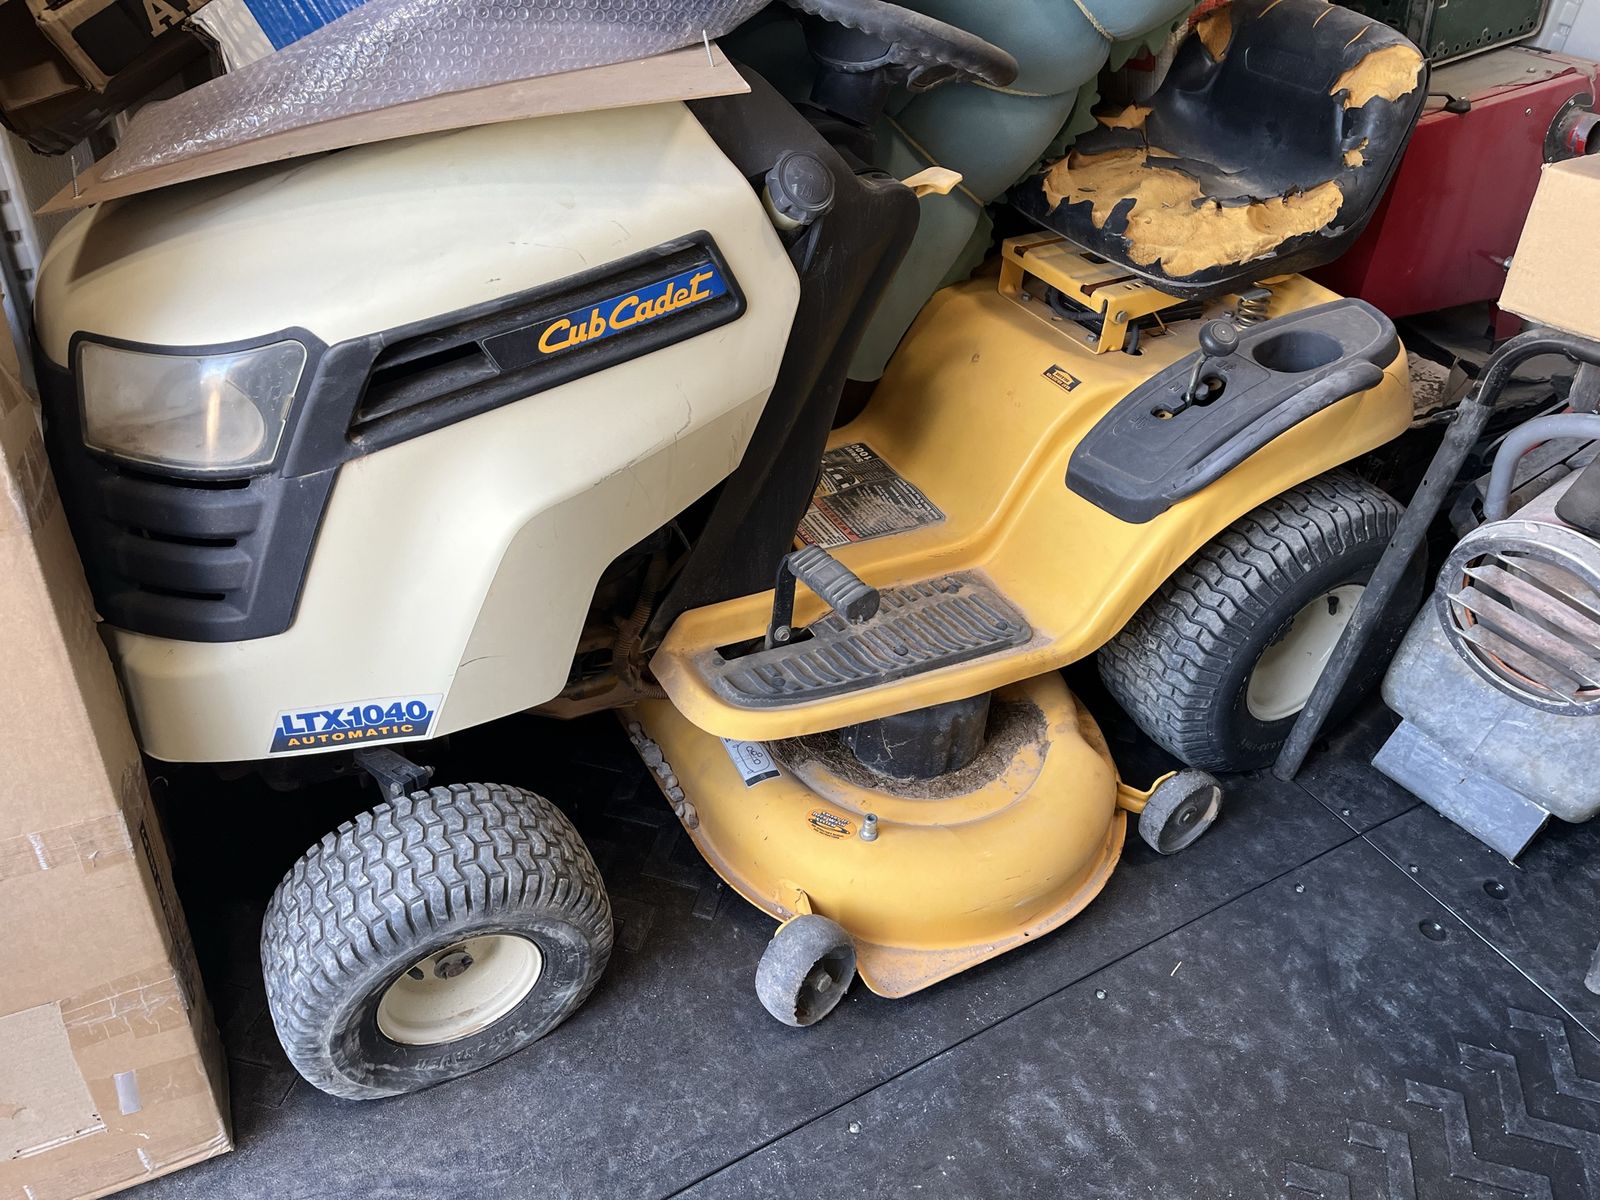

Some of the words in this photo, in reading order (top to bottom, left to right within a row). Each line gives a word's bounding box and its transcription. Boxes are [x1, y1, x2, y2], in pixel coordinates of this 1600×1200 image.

[538, 308, 606, 354] Cub
[608, 271, 713, 330] Cadet
[288, 724, 413, 747] AUTOMATIC
